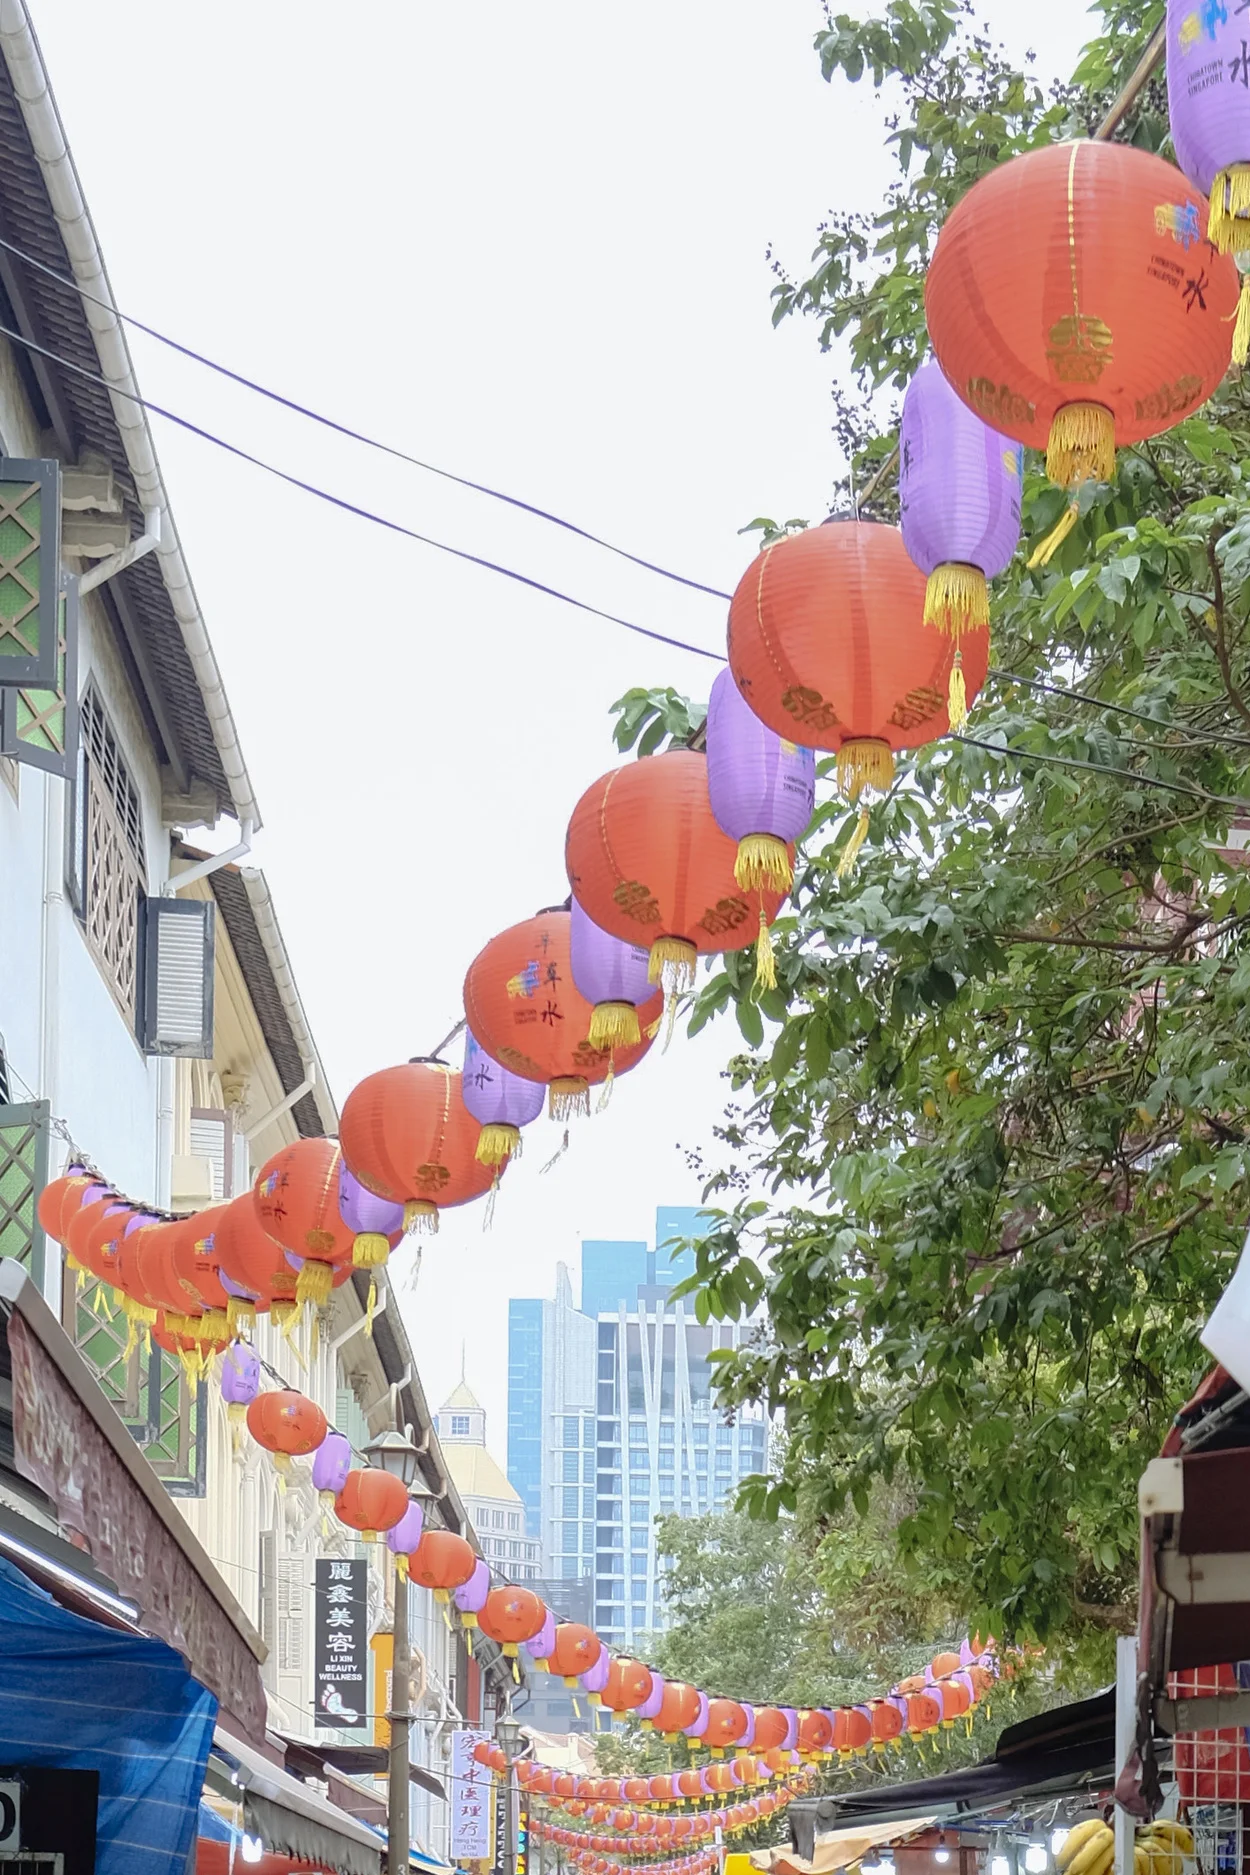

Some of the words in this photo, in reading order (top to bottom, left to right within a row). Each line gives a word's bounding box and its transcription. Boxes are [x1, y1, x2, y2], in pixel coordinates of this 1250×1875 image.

[1187, 72, 1223, 98] SINGAPORE
[326, 1562, 356, 1652] 麗鑫美容
[330, 1655, 338, 1663] LI
[339, 1655, 353, 1663] XIN
[325, 1664, 358, 1672] BEAUTY
[318, 1673, 363, 1681] WELLNESS
